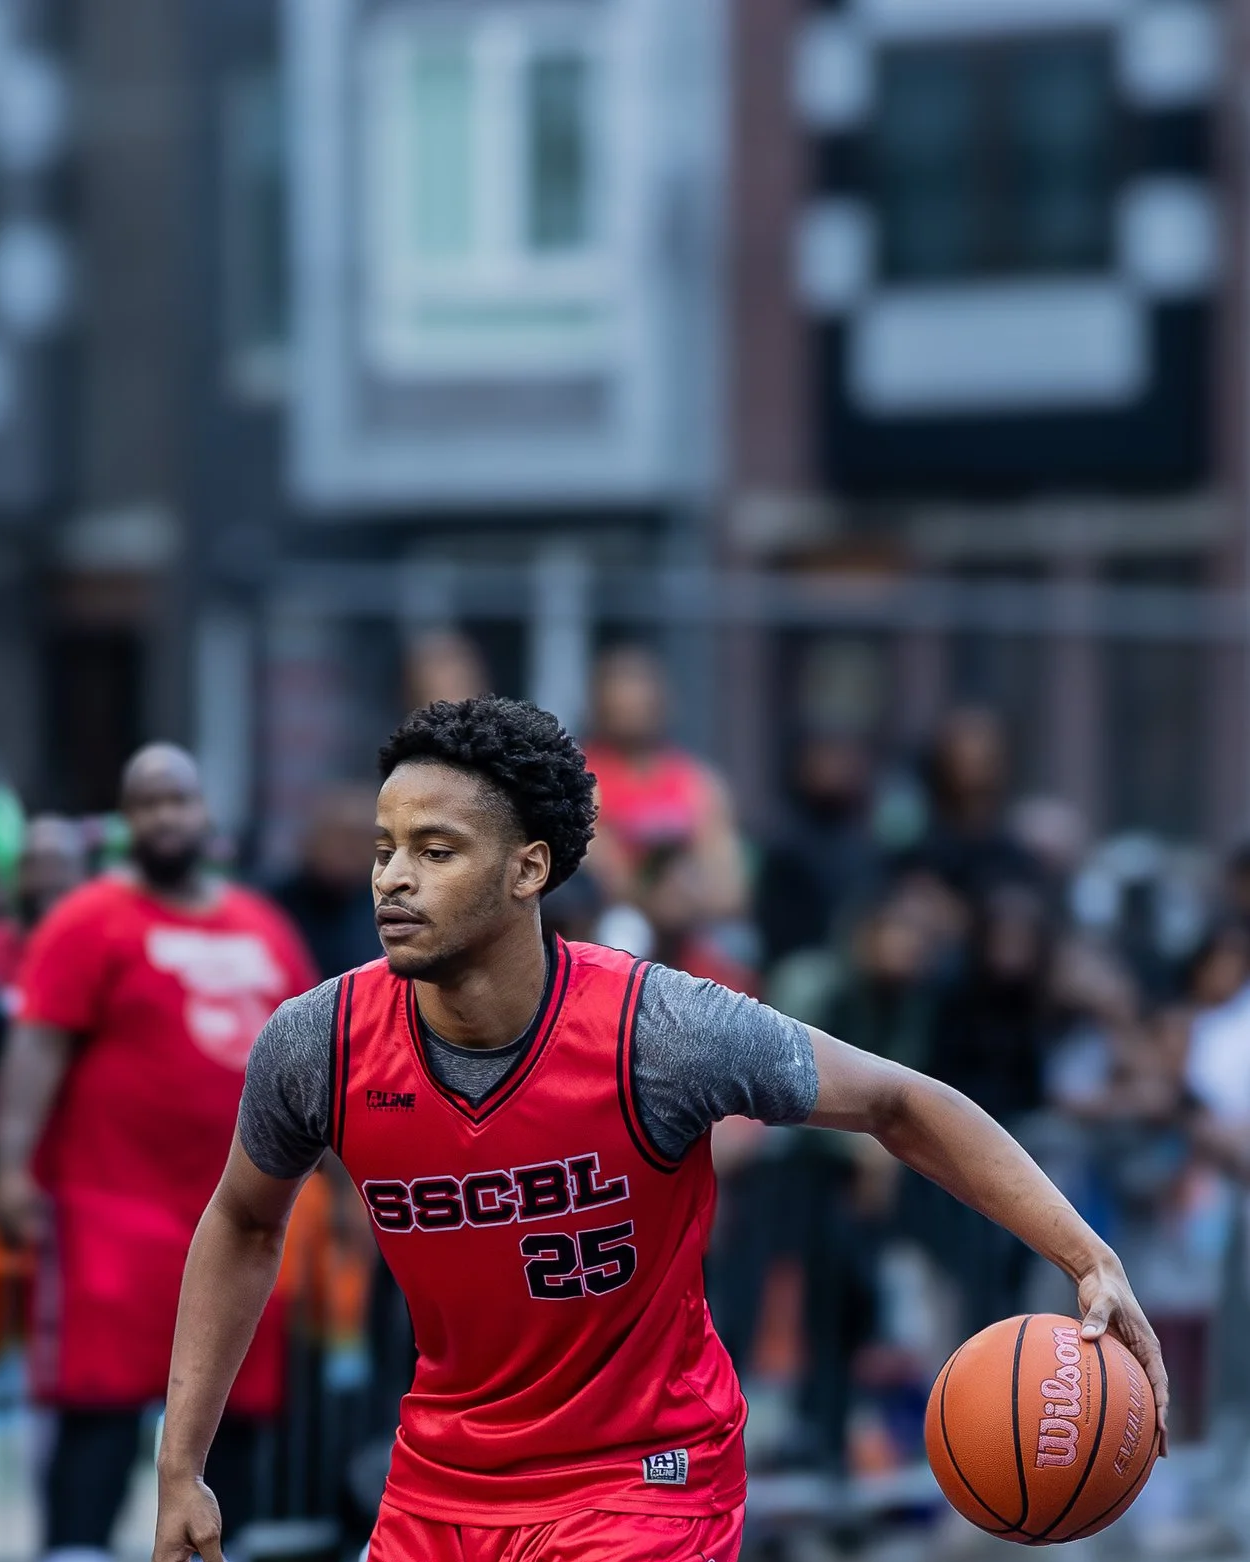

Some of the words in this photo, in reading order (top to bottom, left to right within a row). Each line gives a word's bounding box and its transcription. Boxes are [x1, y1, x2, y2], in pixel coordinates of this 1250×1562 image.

[362, 1152, 630, 1233] SSCBL
[519, 1219, 637, 1300] 25
[1034, 1327, 1082, 1469] Wilson
